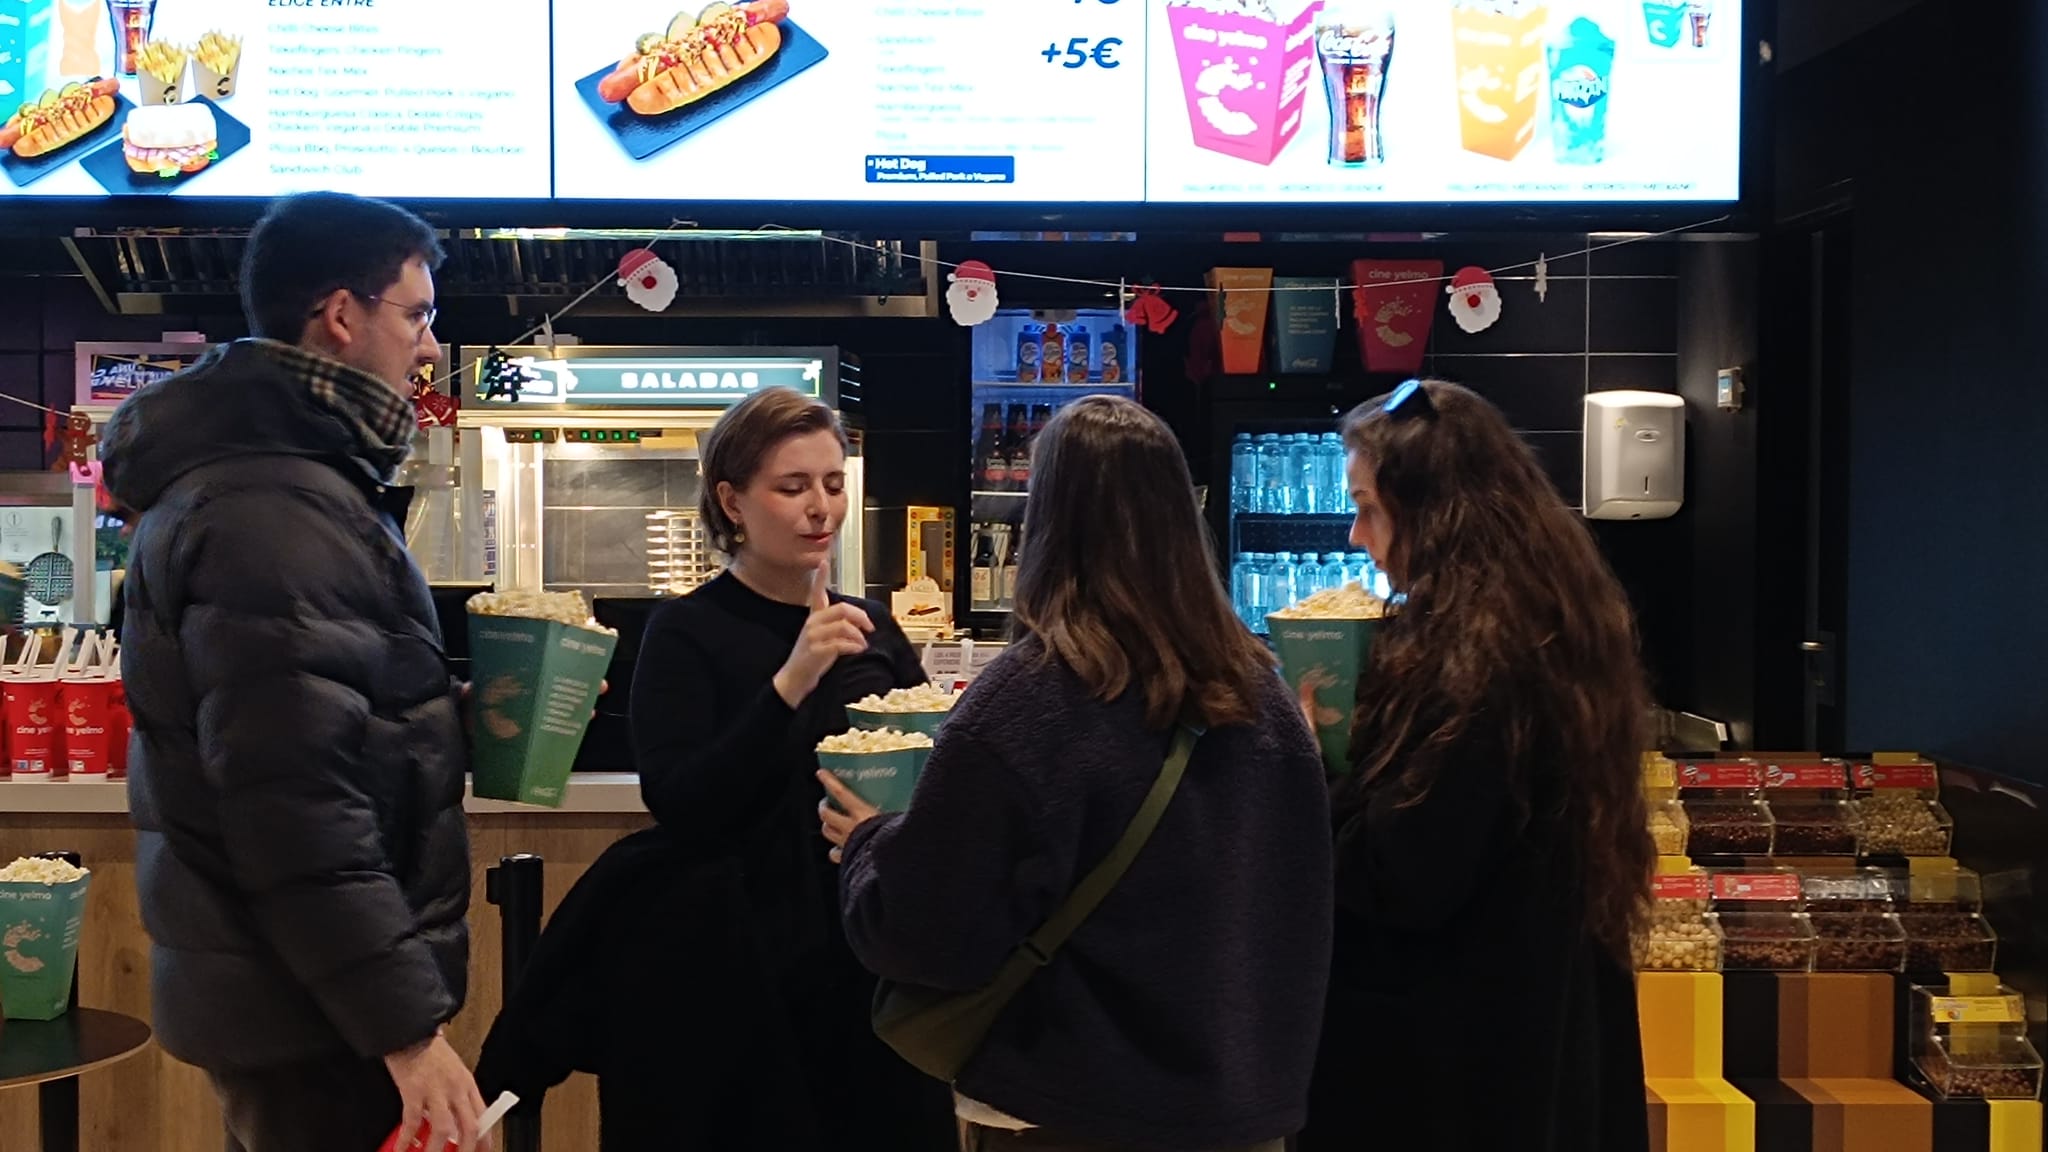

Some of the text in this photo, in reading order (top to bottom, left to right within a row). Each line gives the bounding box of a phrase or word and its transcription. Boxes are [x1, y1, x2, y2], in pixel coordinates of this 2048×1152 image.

[1041, 37, 1124, 69] +5€
[344, 66, 367, 75] Mex
[875, 158, 926, 172] Hot Dog
[1369, 268, 1429, 281] cine yelmo
[621, 372, 759, 389] SALADAS
[16, 725, 36, 734] cine
[75, 726, 104, 736] yelmo
[856, 765, 898, 782] yelmo
[19, 891, 52, 901] yelmo
